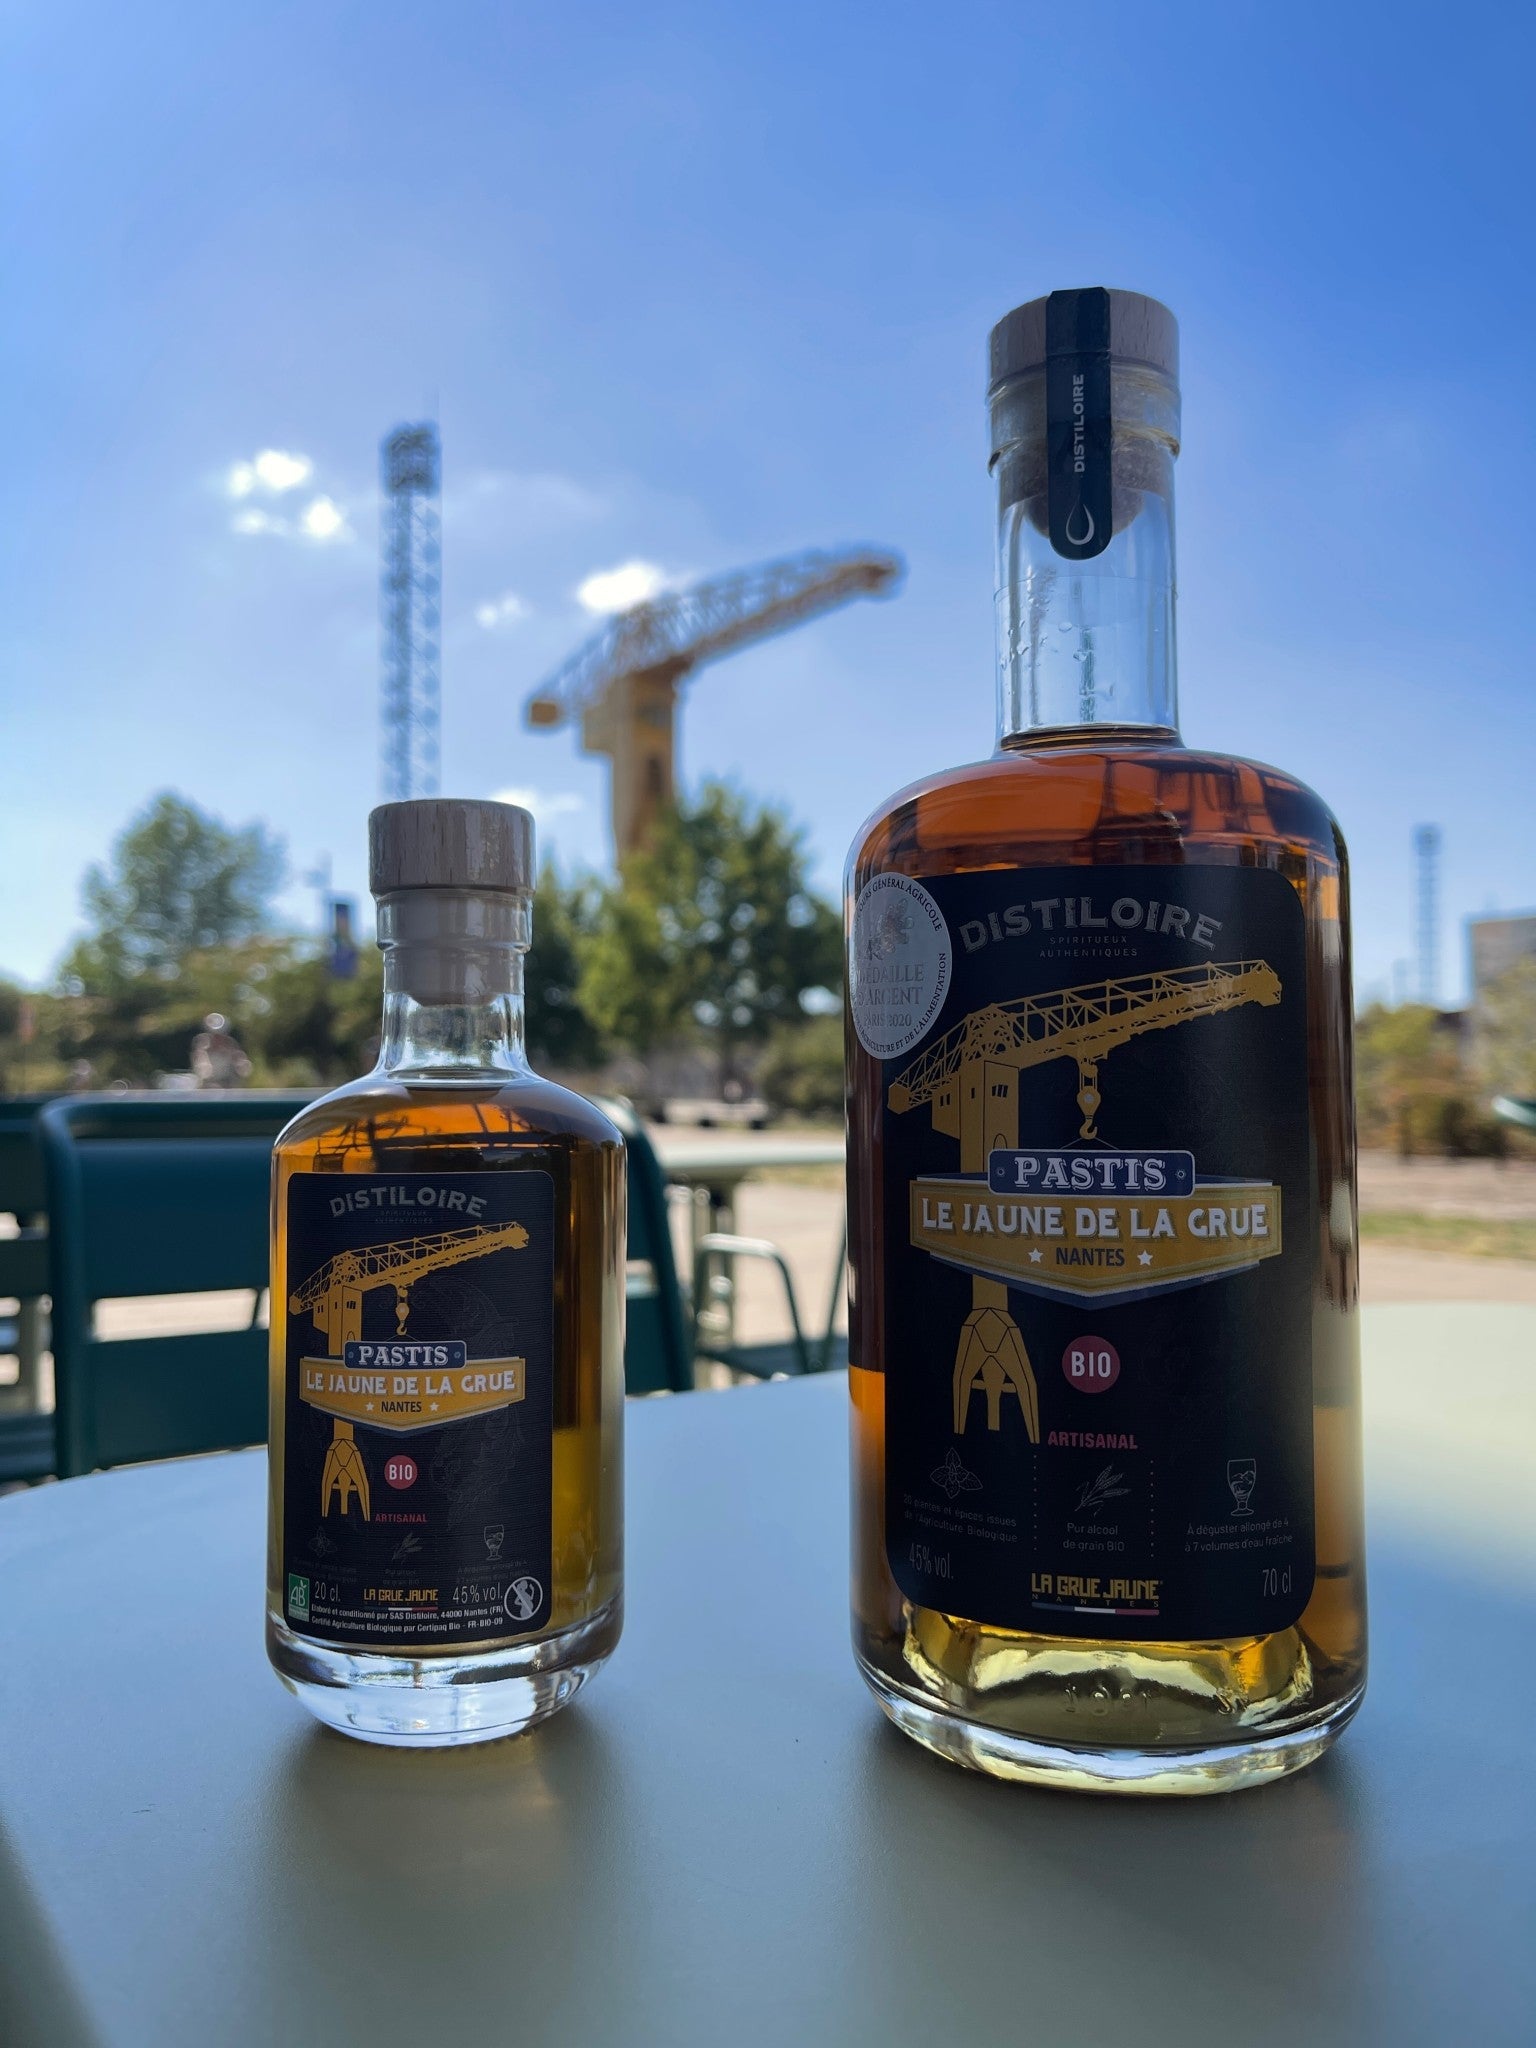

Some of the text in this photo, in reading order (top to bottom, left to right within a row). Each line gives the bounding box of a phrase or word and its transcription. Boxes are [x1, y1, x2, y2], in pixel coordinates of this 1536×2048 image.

[1073, 373, 1085, 474] DISTILOIRE
[873, 876, 904, 892] GÉNÉRAL
[905, 884, 943, 932] AGRICOLE
[959, 896, 1223, 952] DISTILOIRE
[1048, 935, 1128, 945] SPIRITUEUX
[1039, 948, 1138, 958] AUTHENTIQUES
[895, 1039, 904, 1050] ET
[904, 1031, 915, 1044] DE
[914, 952, 946, 1034] L'ALIMENTATION
[1013, 1156, 1167, 1191] PASTIS
[329, 1186, 488, 1218] DISTILOIRE
[921, 1197, 954, 1231] LE
[962, 1203, 1065, 1236] JAUNE
[1074, 1206, 1122, 1238] DE
[1129, 1207, 1177, 1238] LA
[1055, 1247, 1125, 1268] NANTES
[357, 1345, 449, 1366] PASTIS
[1070, 1350, 1112, 1378] BIO
[306, 1369, 324, 1391] LE
[329, 1375, 387, 1394] JAUNE
[393, 1376, 418, 1395] DE
[425, 1376, 453, 1395] LA
[381, 1401, 422, 1412] NANTES
[1047, 1430, 1139, 1451] ARTISANAL
[388, 1464, 413, 1480] BIO
[375, 1513, 428, 1524] ARTISANAL
[986, 1513, 1017, 1527] issues
[1066, 1522, 1118, 1536] Pur alcool
[1196, 1523, 1239, 1537] déguster
[1272, 1518, 1283, 1529] de
[967, 1524, 1018, 1543] Biologique
[1062, 1540, 1125, 1552] de grain BIO
[1193, 1541, 1199, 1552] 7
[1200, 1539, 1240, 1552] volumes
[909, 1543, 954, 1580] 45% vol.
[1031, 1572, 1160, 1600] LA GRUE JAUNE
[1262, 1564, 1292, 1597] 70 cl
[291, 1586, 306, 1606] AB
[314, 1581, 341, 1602] 20 cl.
[363, 1588, 439, 1602] LA GRUE JAUNE
[452, 1582, 503, 1604] 45% vol.
[1032, 1594, 1159, 1607] NANTES
[332, 1607, 338, 1616] et
[339, 1608, 375, 1619] conditionné
[376, 1612, 388, 1621] par
[389, 1611, 404, 1620] SAS
[441, 1609, 463, 1619] 44000
[464, 1607, 488, 1617] Nantes
[490, 1604, 504, 1616] (FR)
[332, 1619, 365, 1631] Agriculture
[366, 1622, 402, 1633] Biologique
[403, 1625, 415, 1634] par
[417, 1622, 447, 1633] Certipaq
[448, 1622, 461, 1630] Bio
[469, 1616, 504, 1629] FR-BIO-09
